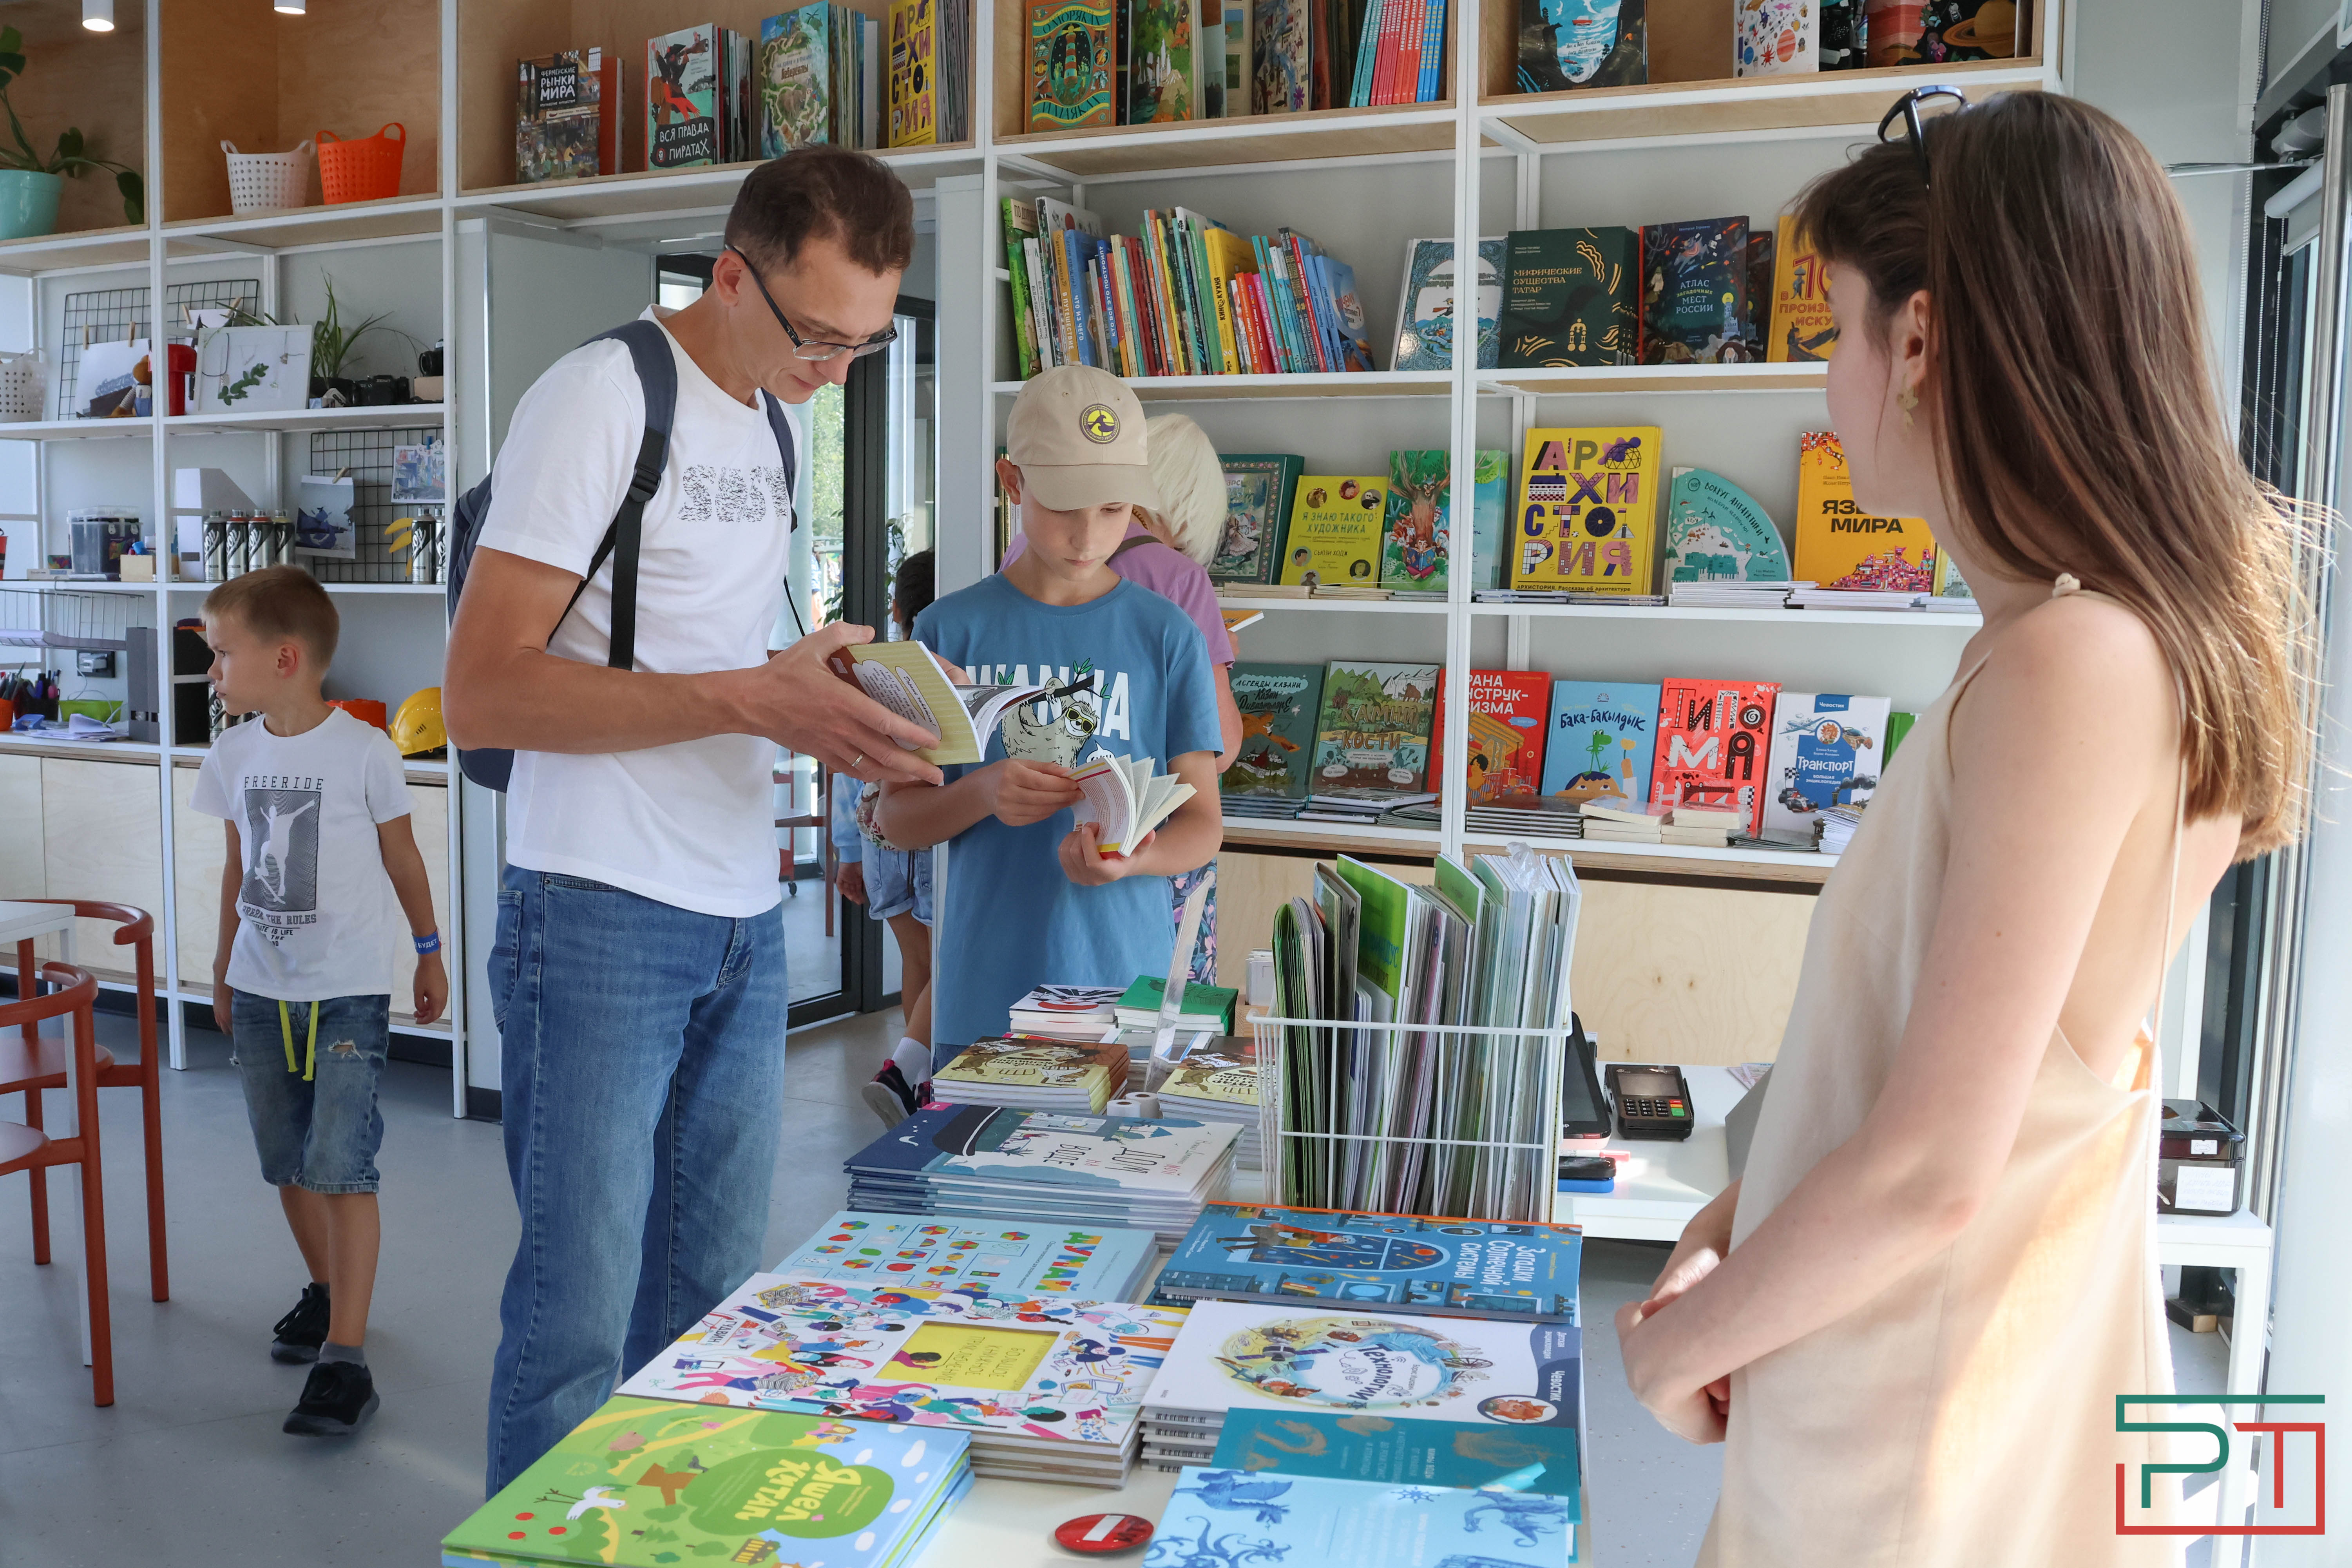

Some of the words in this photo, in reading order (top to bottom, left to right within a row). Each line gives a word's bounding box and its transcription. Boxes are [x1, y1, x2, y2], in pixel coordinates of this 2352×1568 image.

[541, 67, 576, 76] ФЕРМЕРСКИЕ
[541, 75, 575, 87] РЫНКИ
[540, 87, 575, 101] МИРА
[659, 129, 675, 142] ВСЯ
[677, 123, 709, 138] ПРАВДА
[669, 138, 710, 160] ПИРАТАХ
[1099, 246, 1109, 290] ПОСТРОИЛ?
[1514, 267, 1582, 276] МИФИЧЕСКИЕ
[1680, 279, 1710, 289] АТЛАС
[1677, 289, 1713, 298] загадочных
[1682, 295, 1707, 305] МЕСТ
[1781, 291, 1789, 301] В
[1676, 304, 1713, 314] РОССИИ
[1076, 311, 1082, 322] ИЗ
[1063, 298, 1074, 350] ПУТЕШЕСТВИЕ
[1705, 482, 1729, 499] ВОКРУГ
[1302, 512, 1308, 521] Я
[1311, 513, 1336, 521] ЗНАЮ
[1340, 513, 1374, 522] ТАКОГО
[1307, 523, 1365, 533] ХУДОЖНИКА
[1831, 518, 1903, 533] МИРА
[1273, 681, 1301, 689] КАЗАНИ
[1469, 675, 1503, 687] РАНА
[1255, 688, 1278, 701] Казан
[1468, 688, 1528, 701] НСТРУК-
[1341, 704, 1419, 723] КАМНИ
[1342, 732, 1402, 751] КОСТИ
[1798, 756, 1854, 773] Транспорт
[244, 776, 324, 790] FREERIDE
[266, 913, 281, 925] THE
[286, 913, 317, 925] RULES
[418, 938, 438, 949] БУДЕТ
[1043, 1144, 1092, 1166] ВОДЕ
[1104, 1147, 1166, 1173] ДОМ
[1161, 1164, 1182, 1176] МОЙ
[1035, 1232, 1103, 1291] ДУМАЙ
[1454, 1242, 1482, 1279] системы
[1480, 1240, 1515, 1286] Солнечной
[1512, 1246, 1546, 1282] Загадки
[707, 1321, 738, 1343] ГУДВИН
[1557, 1332, 1567, 1347] Детская
[1346, 1343, 1393, 1400] Технологии
[1550, 1371, 1565, 1401] Чевостик
[775, 1460, 862, 1521] Яшел
